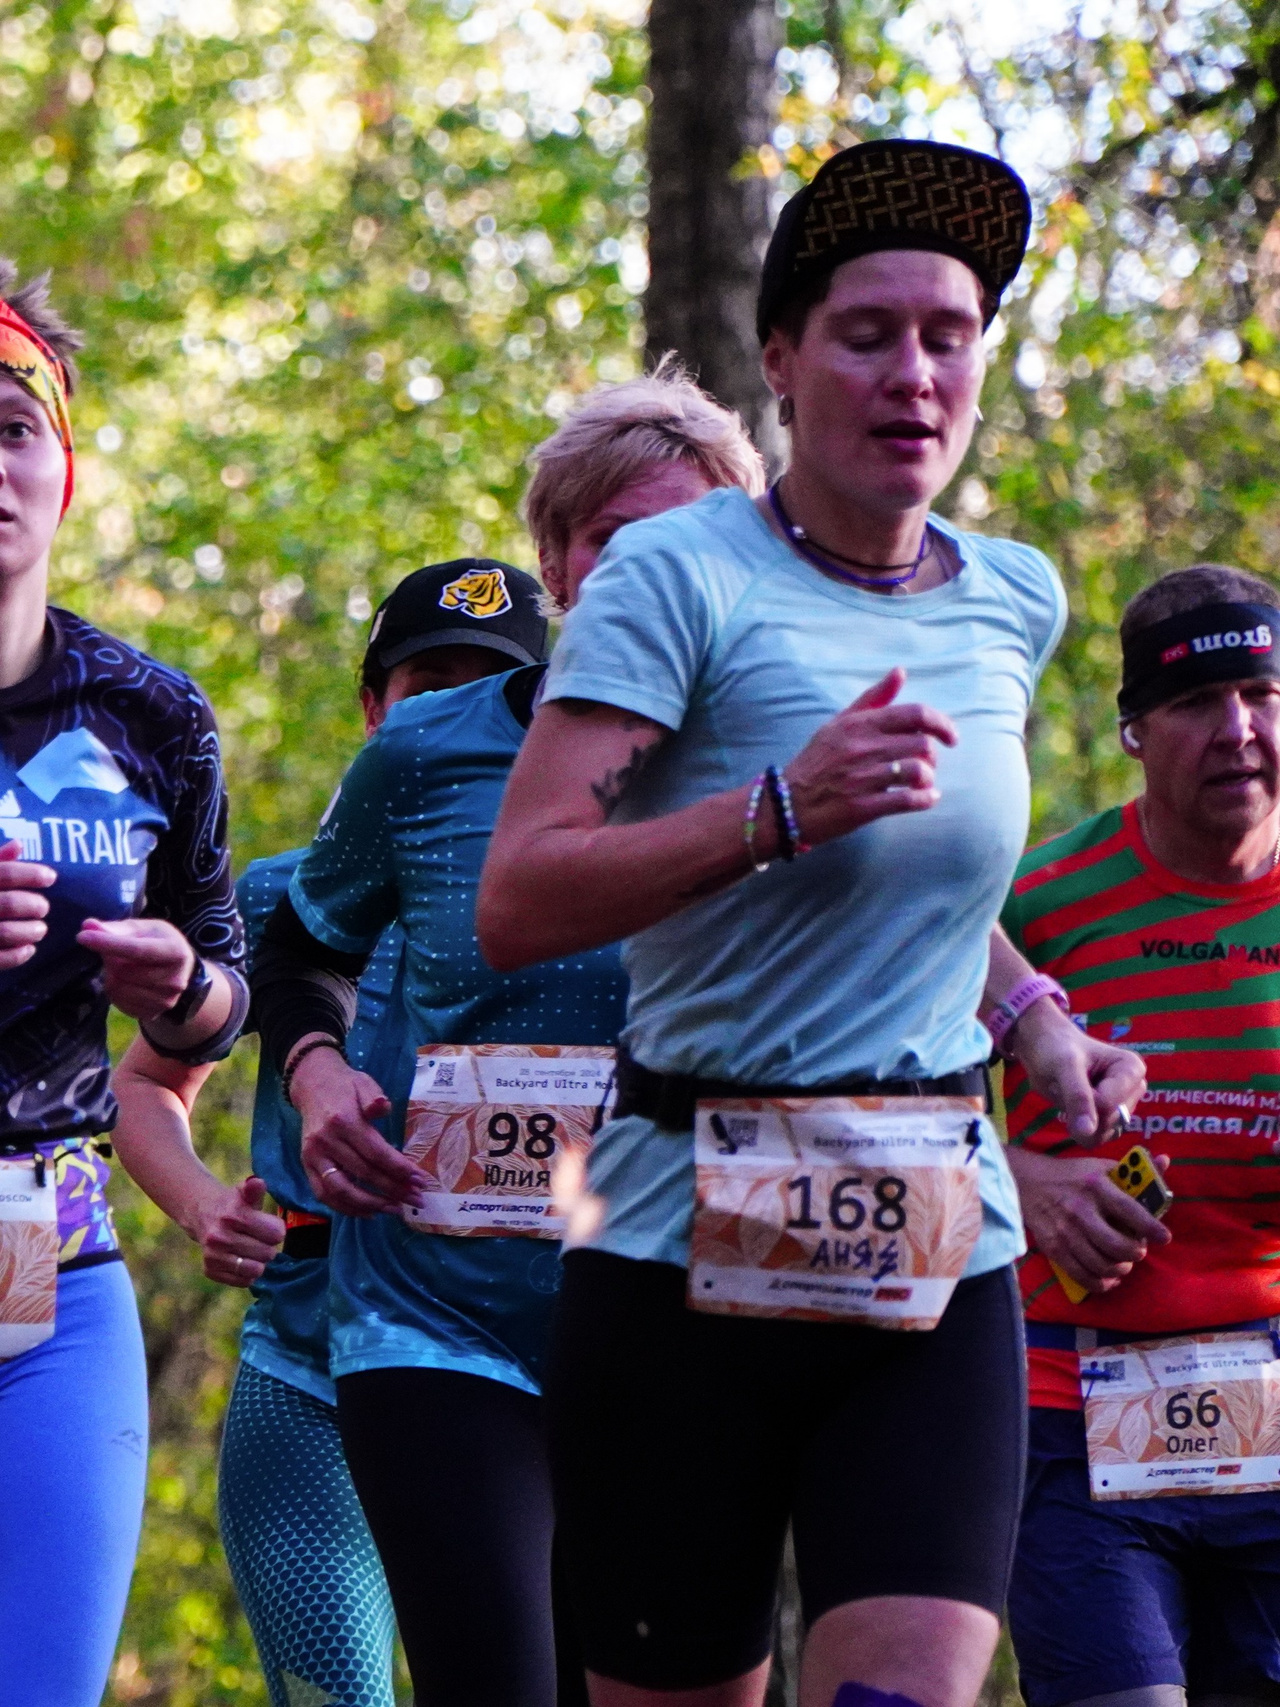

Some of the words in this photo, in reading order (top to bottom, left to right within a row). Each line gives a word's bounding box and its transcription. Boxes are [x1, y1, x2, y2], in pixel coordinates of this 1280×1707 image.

[1192, 624, 1273, 653] grom
[42, 817, 139, 866] TRAIL
[1140, 939, 1280, 965] VOLGAMAN
[496, 1078, 548, 1090] Backyard
[554, 1079, 588, 1089] Ultra
[488, 1112, 557, 1159] 98
[484, 1165, 550, 1188] Юлия
[787, 1176, 907, 1232] 168
[1165, 1361, 1208, 1374] Backyard
[1166, 1389, 1221, 1429] 66
[1167, 1436, 1218, 1454] Олег
